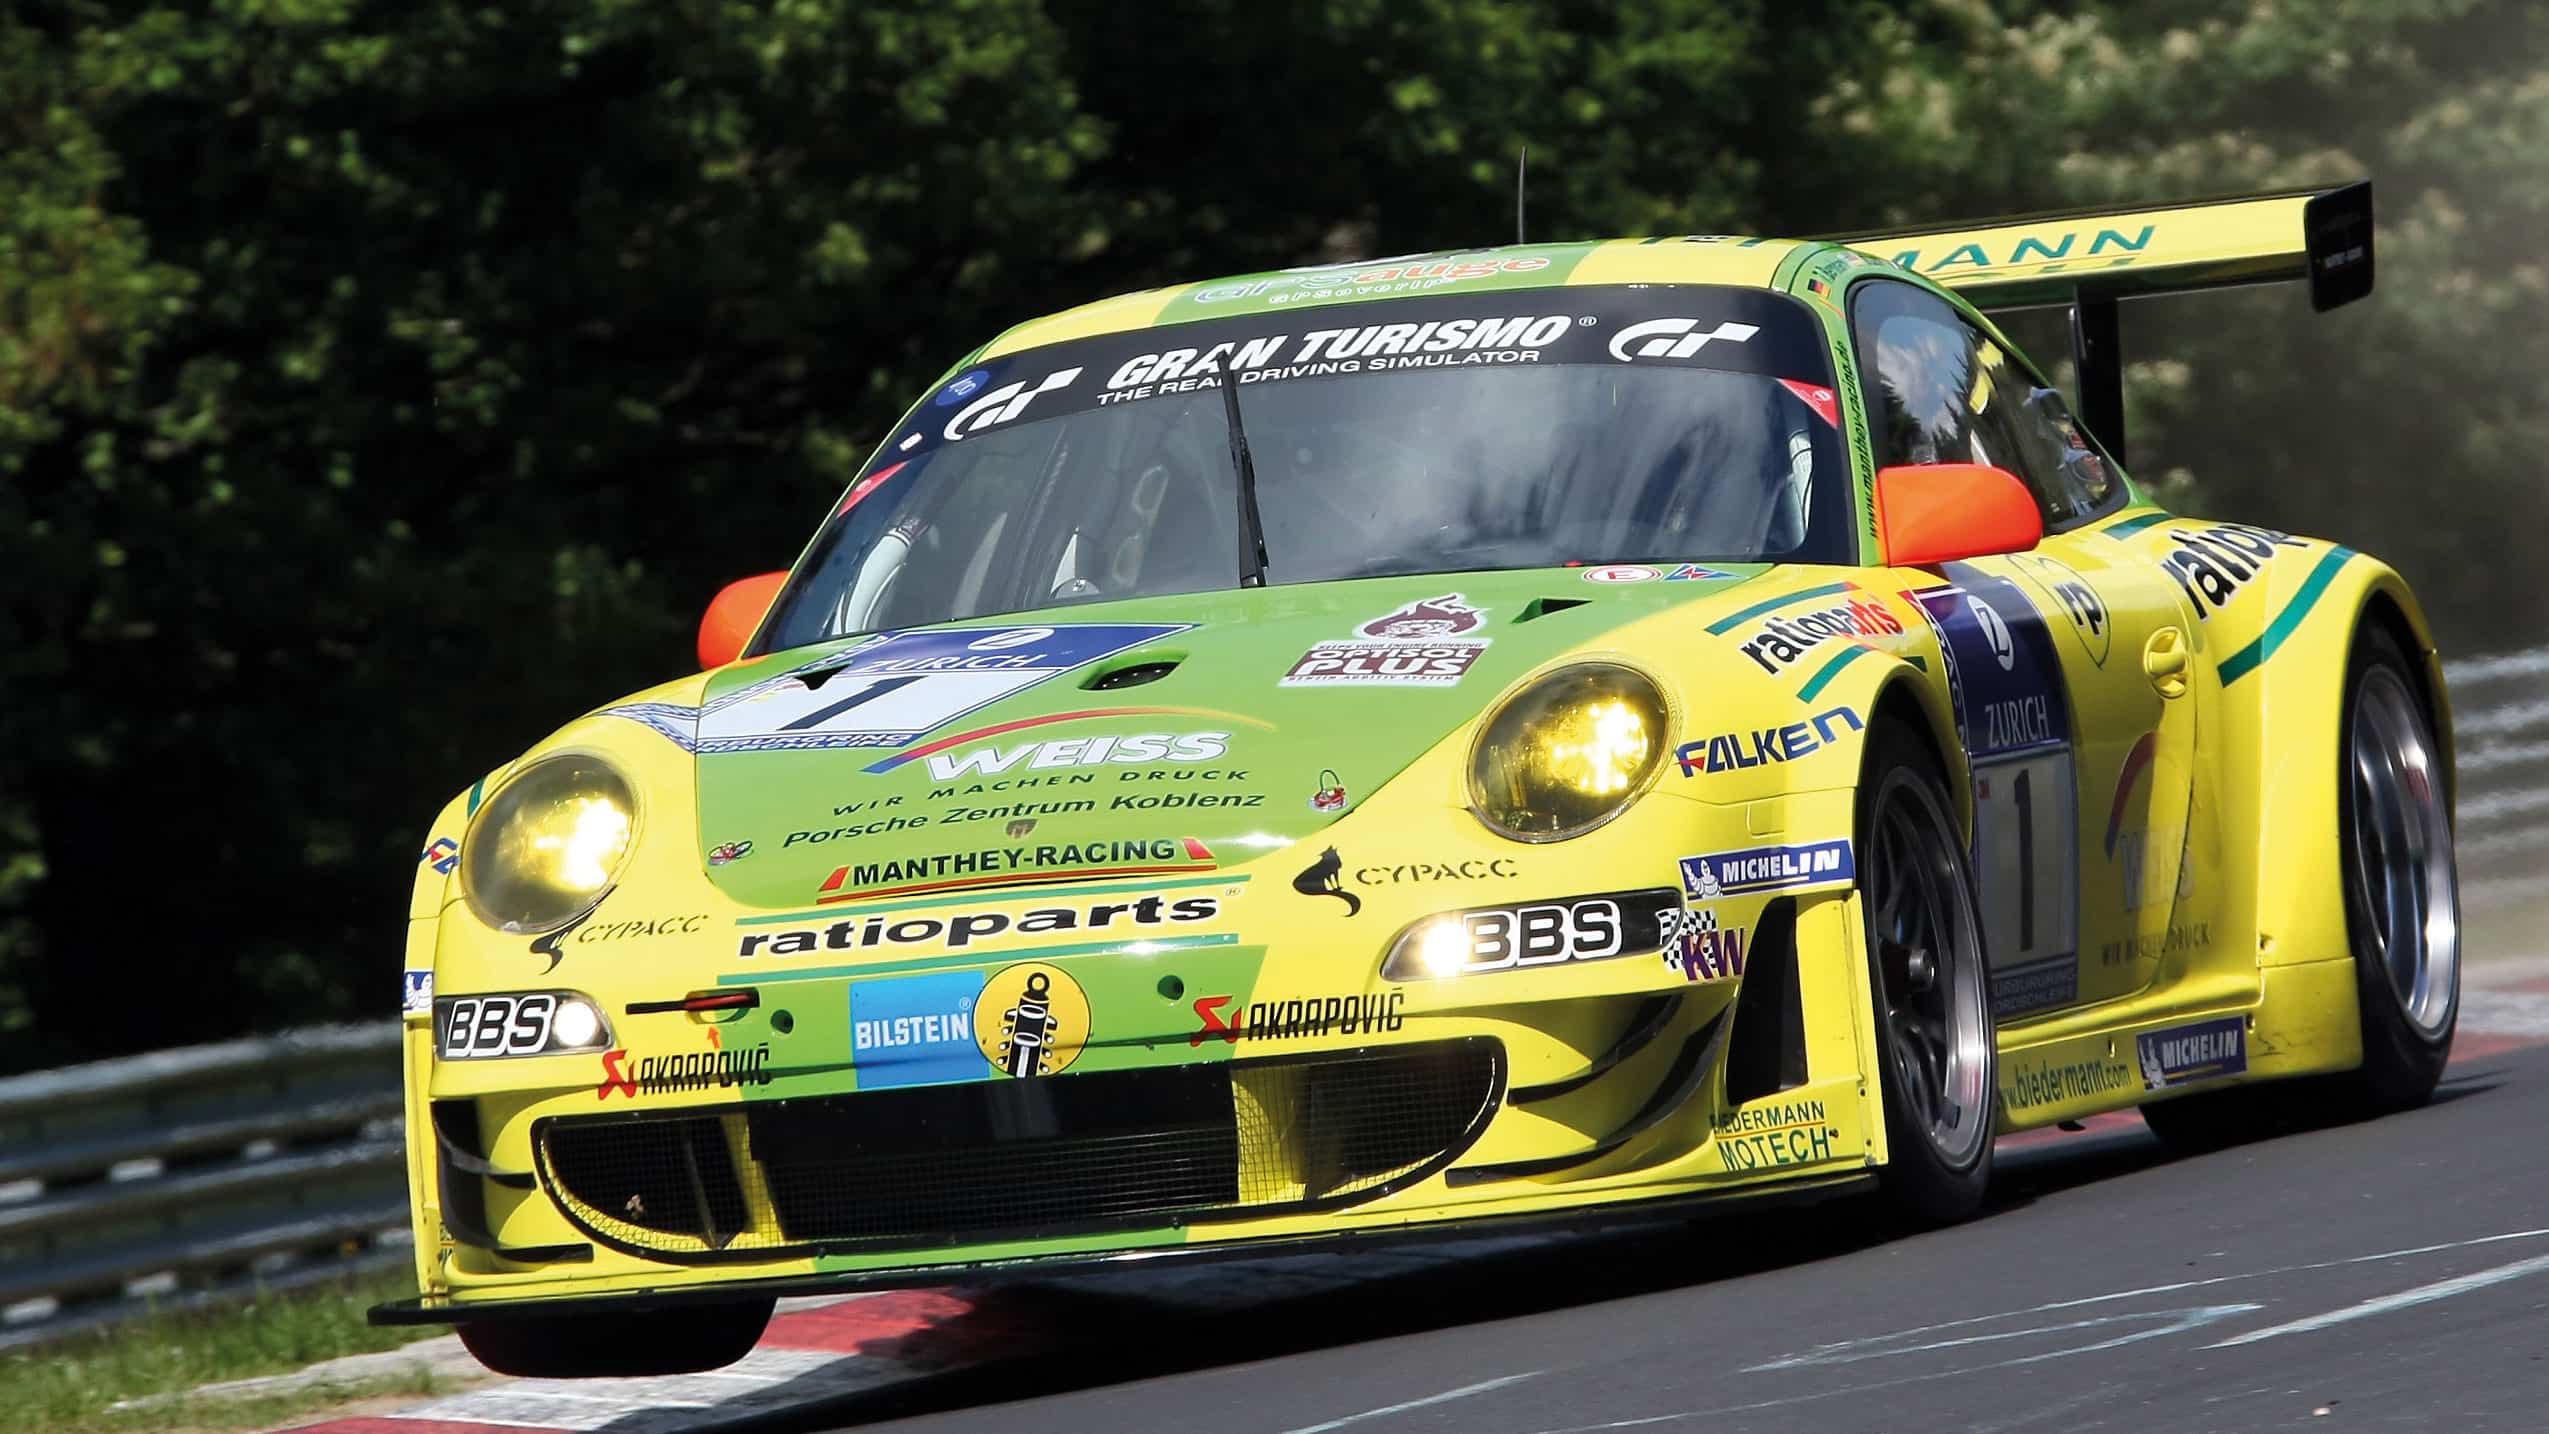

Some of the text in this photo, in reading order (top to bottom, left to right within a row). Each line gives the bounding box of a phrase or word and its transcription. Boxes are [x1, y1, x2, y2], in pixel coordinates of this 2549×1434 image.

[1097, 384, 1153, 405] THE
[1240, 361, 1364, 385] DRIVING
[1368, 350, 1540, 373] SIMULATOR
[1106, 315, 1572, 391] GRAN TURISMO
[1311, 648, 1474, 660] OPTISOL
[1740, 594, 1906, 675] ratioparts
[857, 653, 1048, 673] ZURICH
[1294, 658, 1469, 676] PLUS
[776, 676, 926, 731] 1
[1984, 695, 2050, 749] ZURICH
[928, 733, 1231, 782] WEISS
[1675, 707, 1864, 778] FALKEN
[834, 770, 1249, 816] WIR MACHEN DRUCK
[782, 793, 1265, 848] Porsche Zentrum Koblenz
[852, 839, 1175, 885] MANTHEY-RACING
[1356, 860, 1519, 886] CYPACC
[1722, 848, 1840, 883] MICHELIN
[2013, 768, 2035, 952] 1
[578, 914, 709, 943] CYPACC
[740, 896, 1217, 957] ratioparts
[1463, 900, 1622, 971] BBS
[1680, 928, 1745, 982] KW
[446, 994, 556, 1057] BBS
[855, 1012, 970, 1050] BILSTEIN
[2162, 1030, 2238, 1069] MICHELIN
